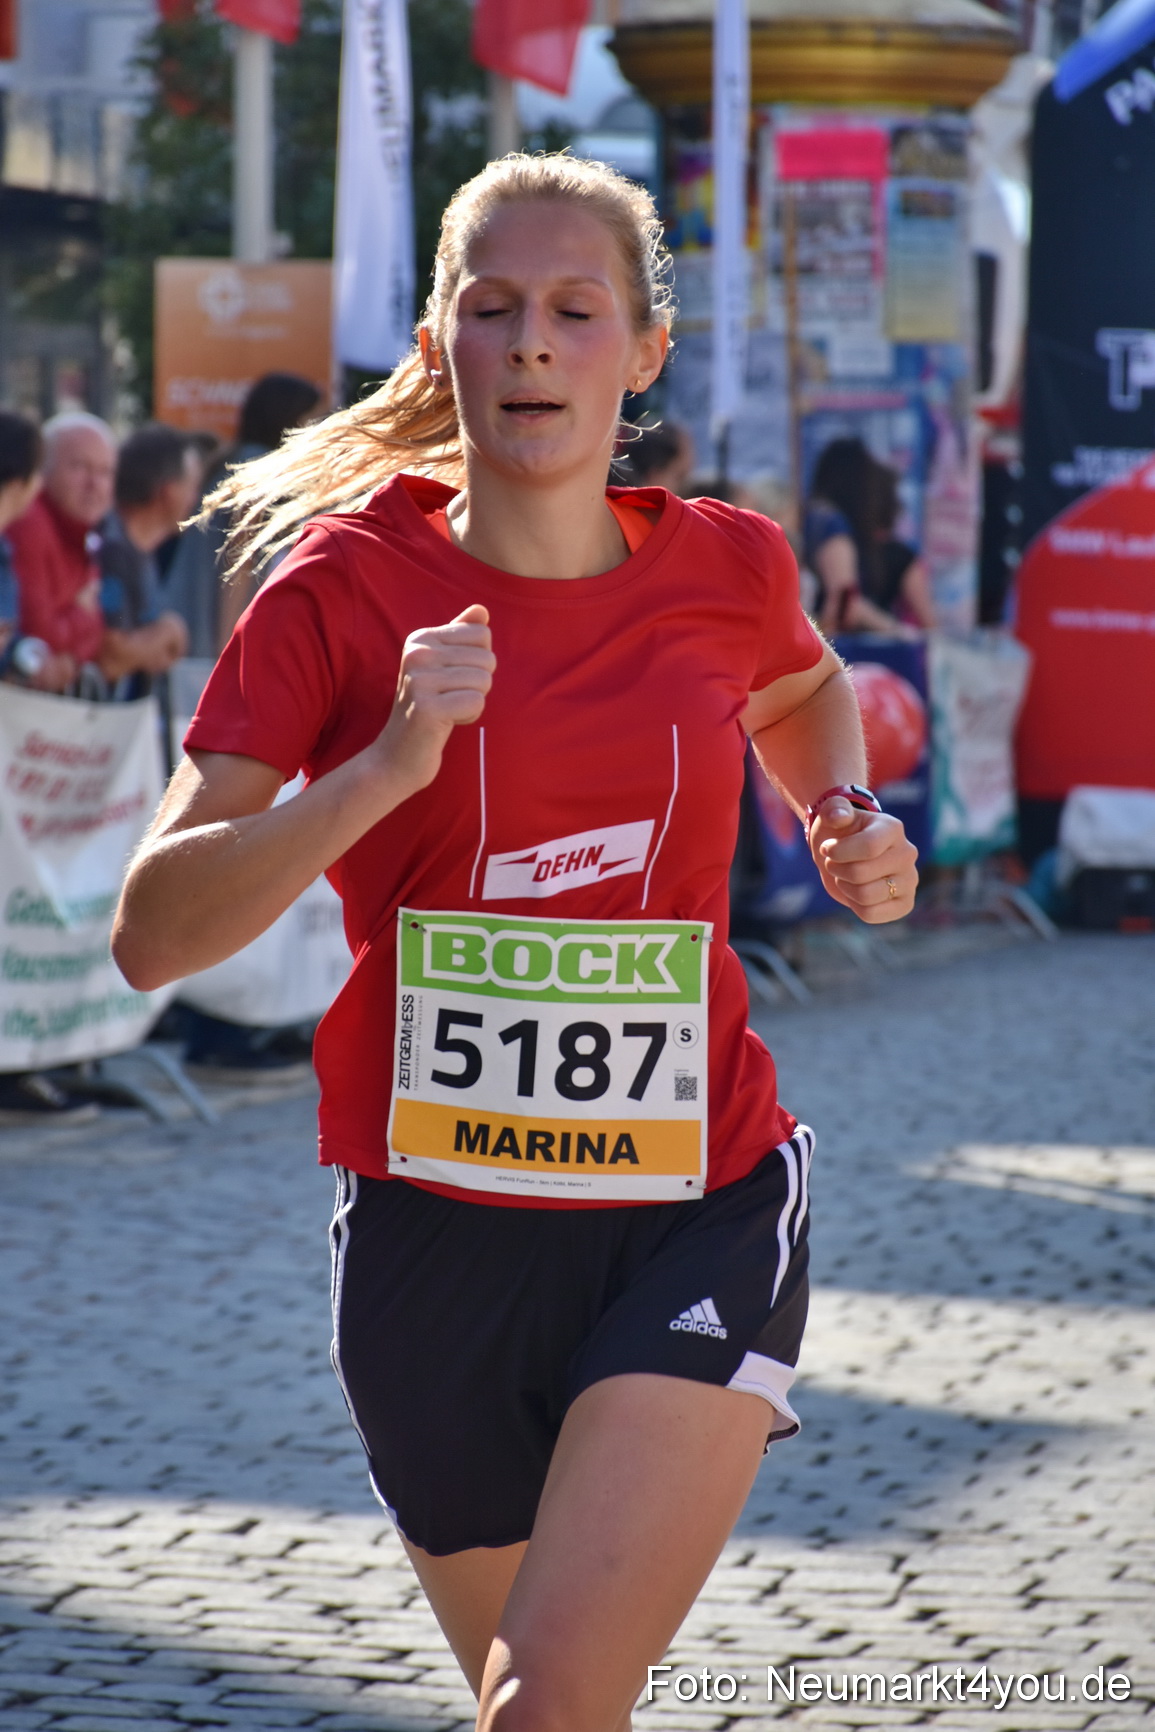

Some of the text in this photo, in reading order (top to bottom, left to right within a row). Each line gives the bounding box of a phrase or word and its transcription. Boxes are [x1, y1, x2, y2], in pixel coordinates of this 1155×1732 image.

[532, 844, 605, 882] DEHN
[423, 924, 681, 993] BOCK
[431, 1008, 667, 1102] 5187
[680, 1027, 692, 1042] S
[454, 1120, 640, 1165] MARINA
[669, 1319, 727, 1340] adidas
